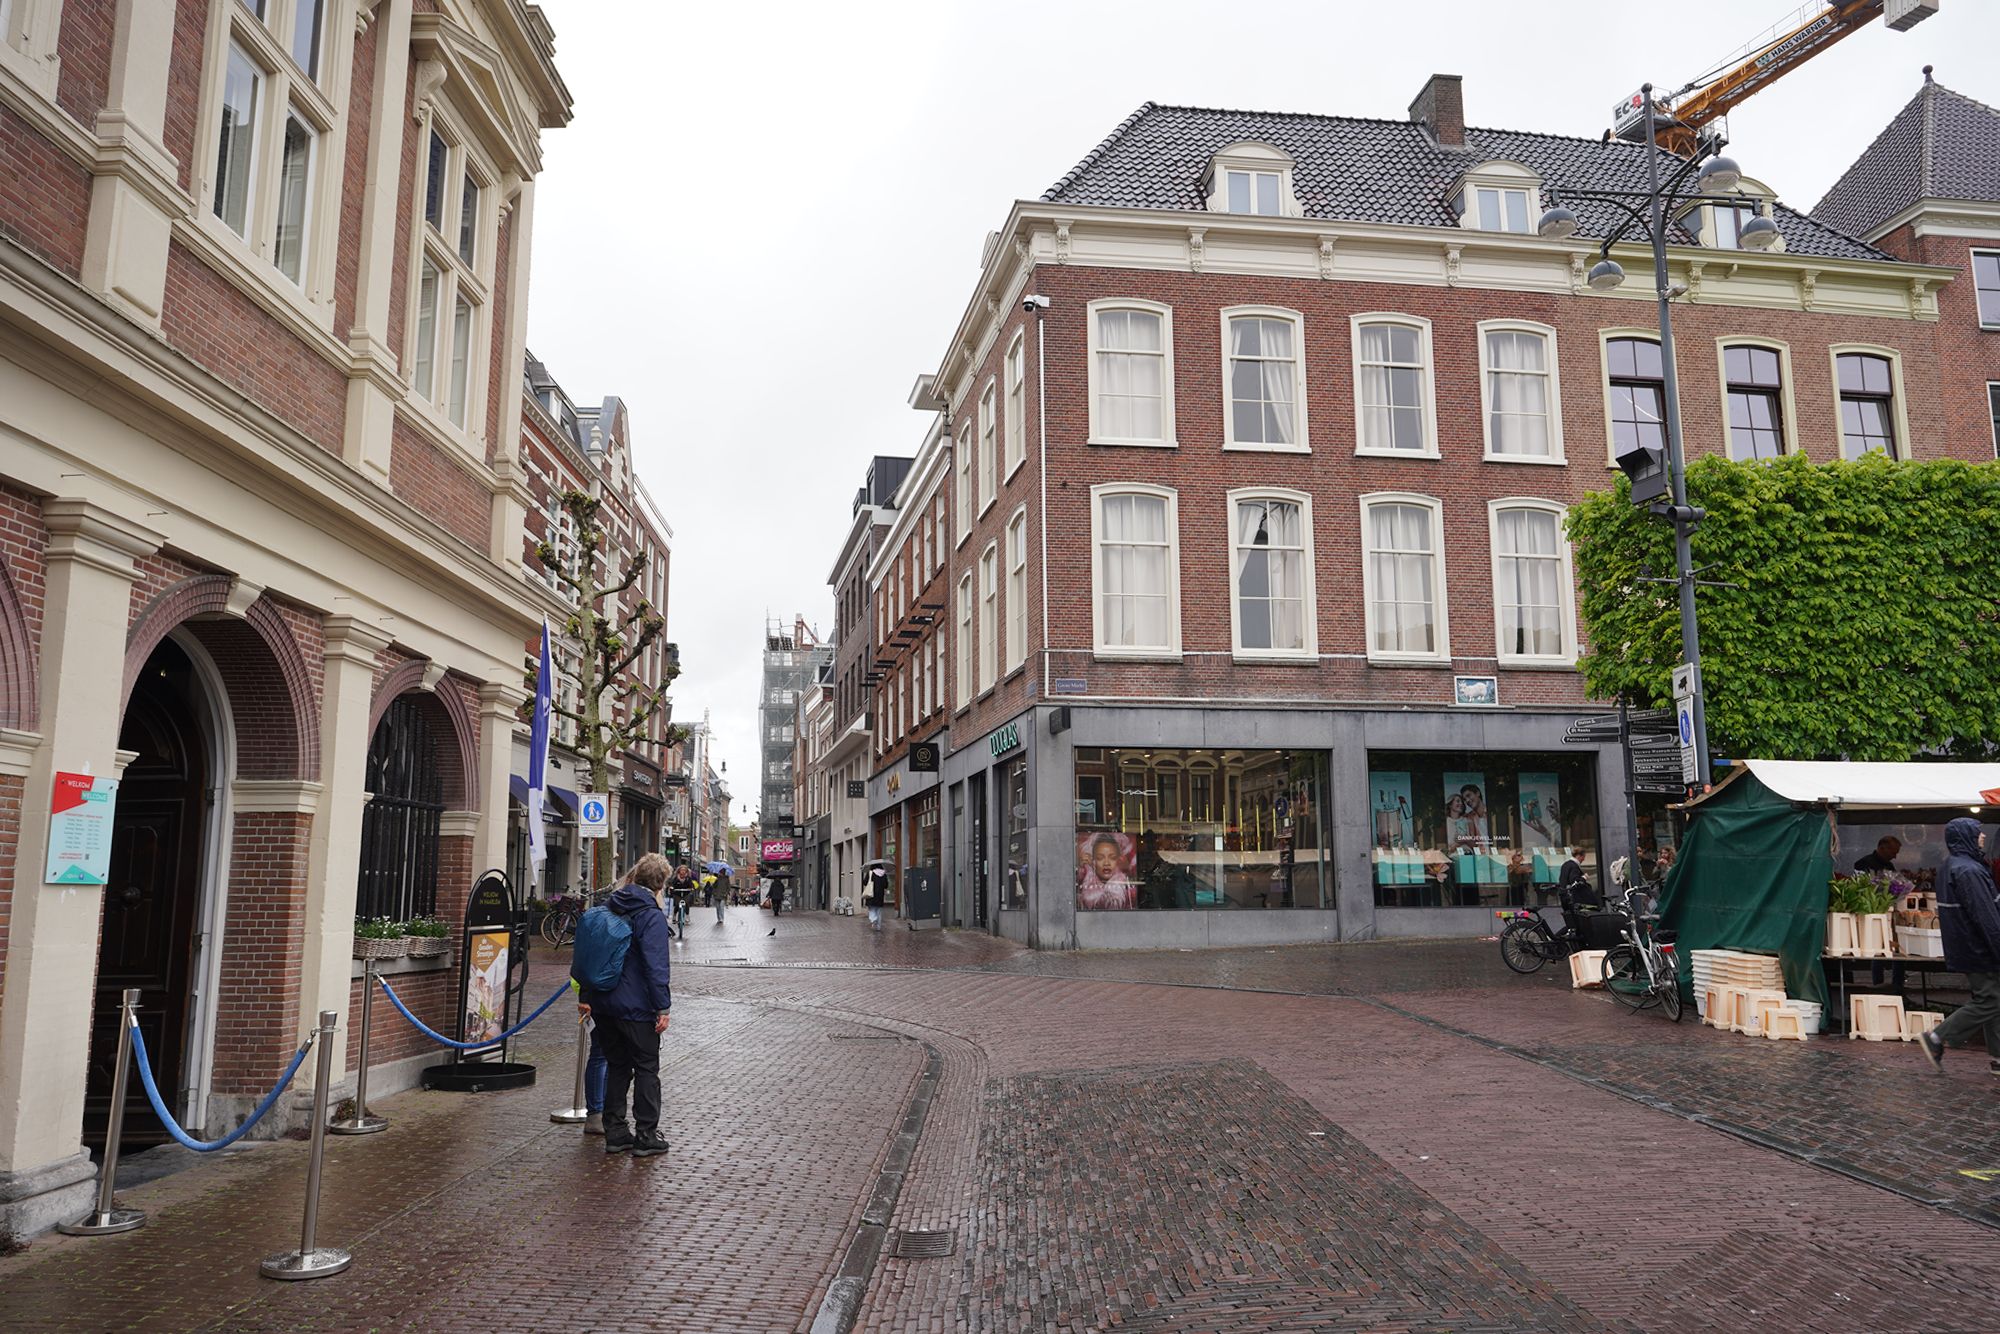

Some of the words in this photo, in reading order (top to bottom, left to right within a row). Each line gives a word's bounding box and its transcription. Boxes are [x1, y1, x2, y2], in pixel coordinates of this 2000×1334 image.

[1771, 40, 1794, 58] HANS
[1793, 18, 1828, 43] WARNER
[1615, 95, 1642, 121] EC-B
[989, 721, 1018, 758] DOUGLAS
[67, 780, 91, 789] WELKOM
[83, 792, 107, 801] WELCOME
